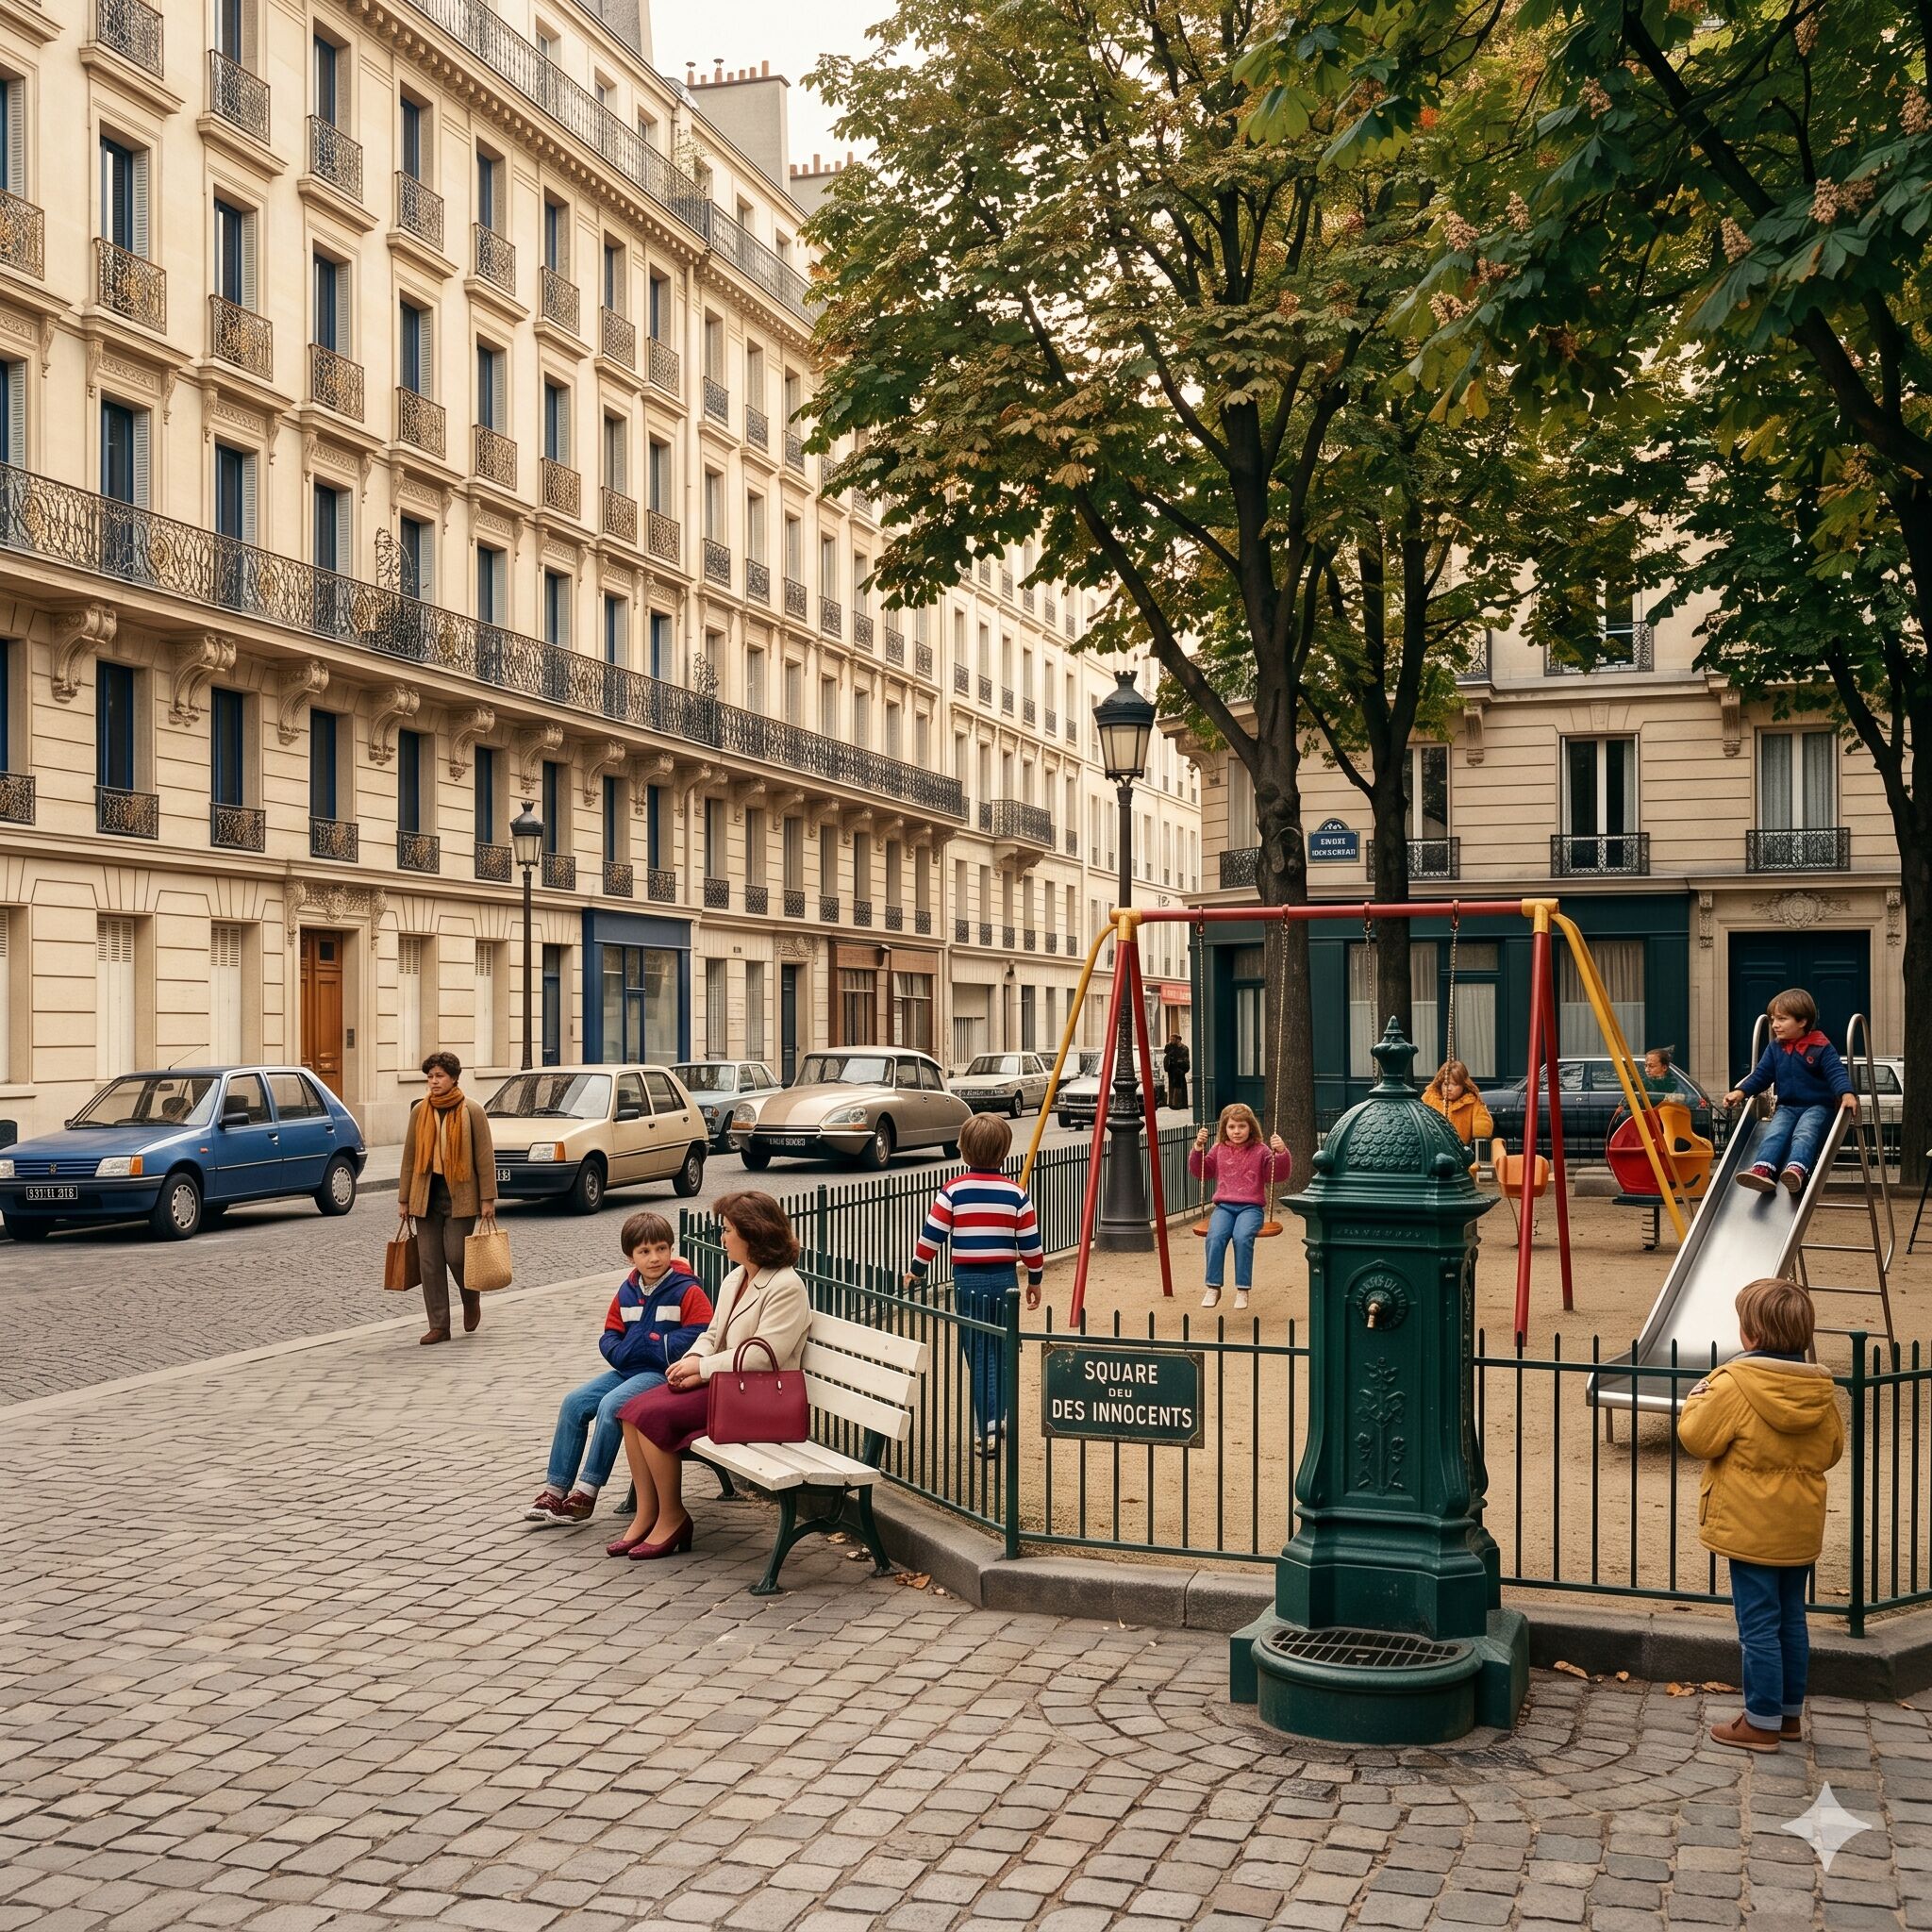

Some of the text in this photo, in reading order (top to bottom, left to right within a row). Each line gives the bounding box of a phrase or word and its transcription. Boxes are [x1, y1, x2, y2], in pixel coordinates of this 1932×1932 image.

[1084, 1360, 1158, 1385] SQUARE
[1108, 1388, 1132, 1398] DEU
[1052, 1399, 1192, 1428] DES INNOCENTS
